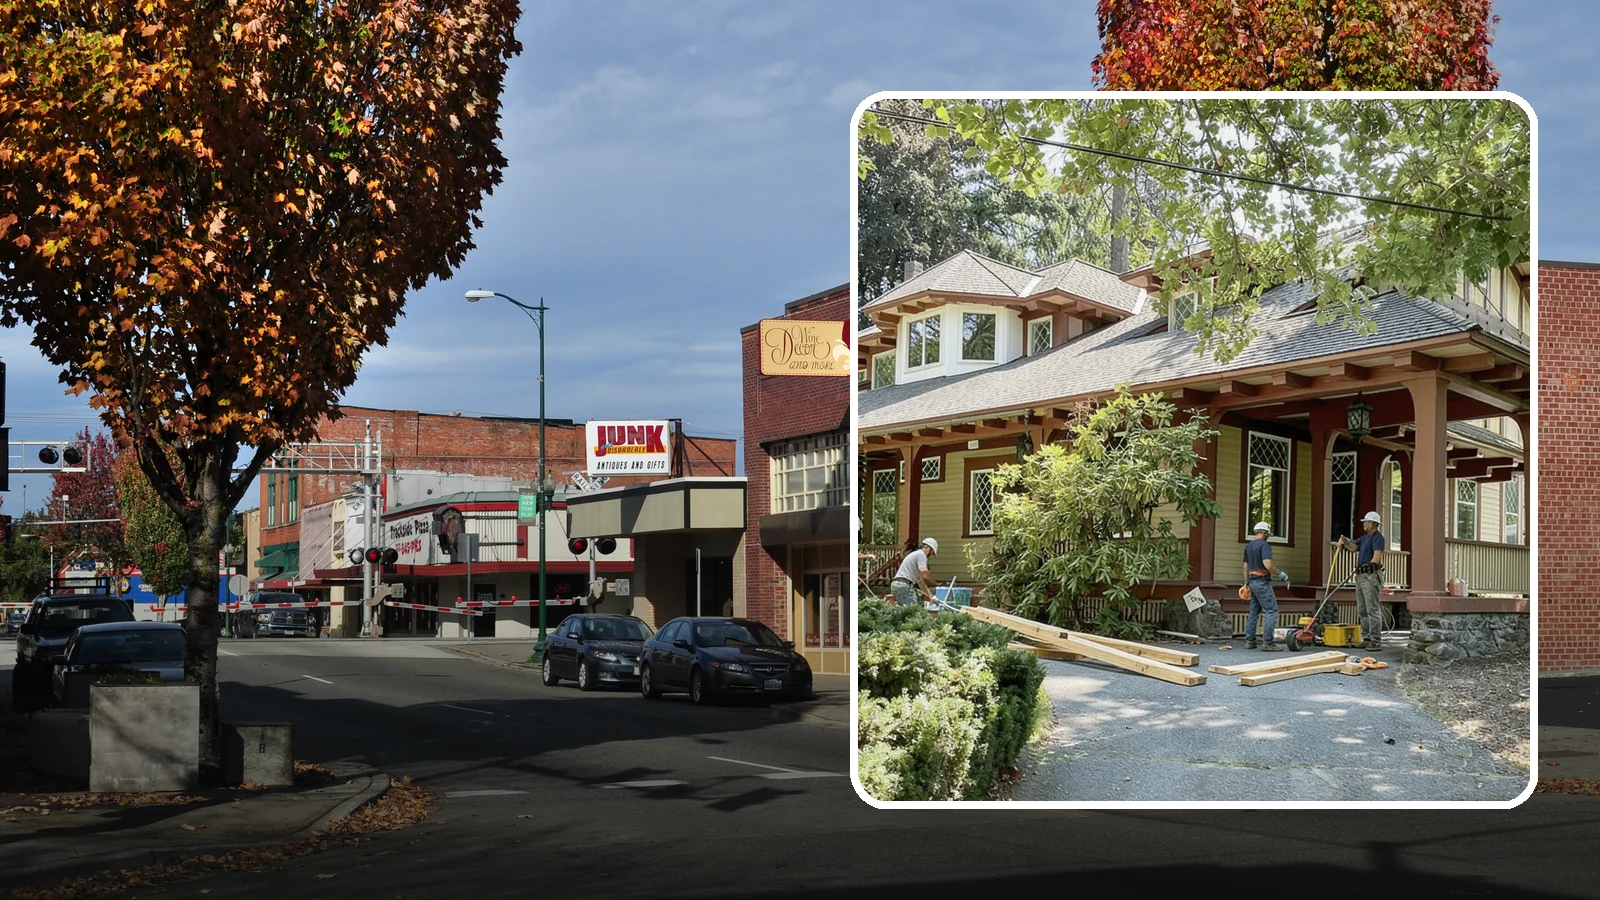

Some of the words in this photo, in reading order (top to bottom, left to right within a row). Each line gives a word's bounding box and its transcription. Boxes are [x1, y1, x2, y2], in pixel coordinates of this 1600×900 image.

[596, 426, 665, 457] JUNK
[607, 446, 646, 454] DISORDERLY
[597, 461, 628, 470] ANTIQUES
[631, 461, 644, 470] AND
[647, 460, 665, 470] GIFTS
[390, 522, 413, 540] Trackside
[414, 519, 429, 535] Pizza
